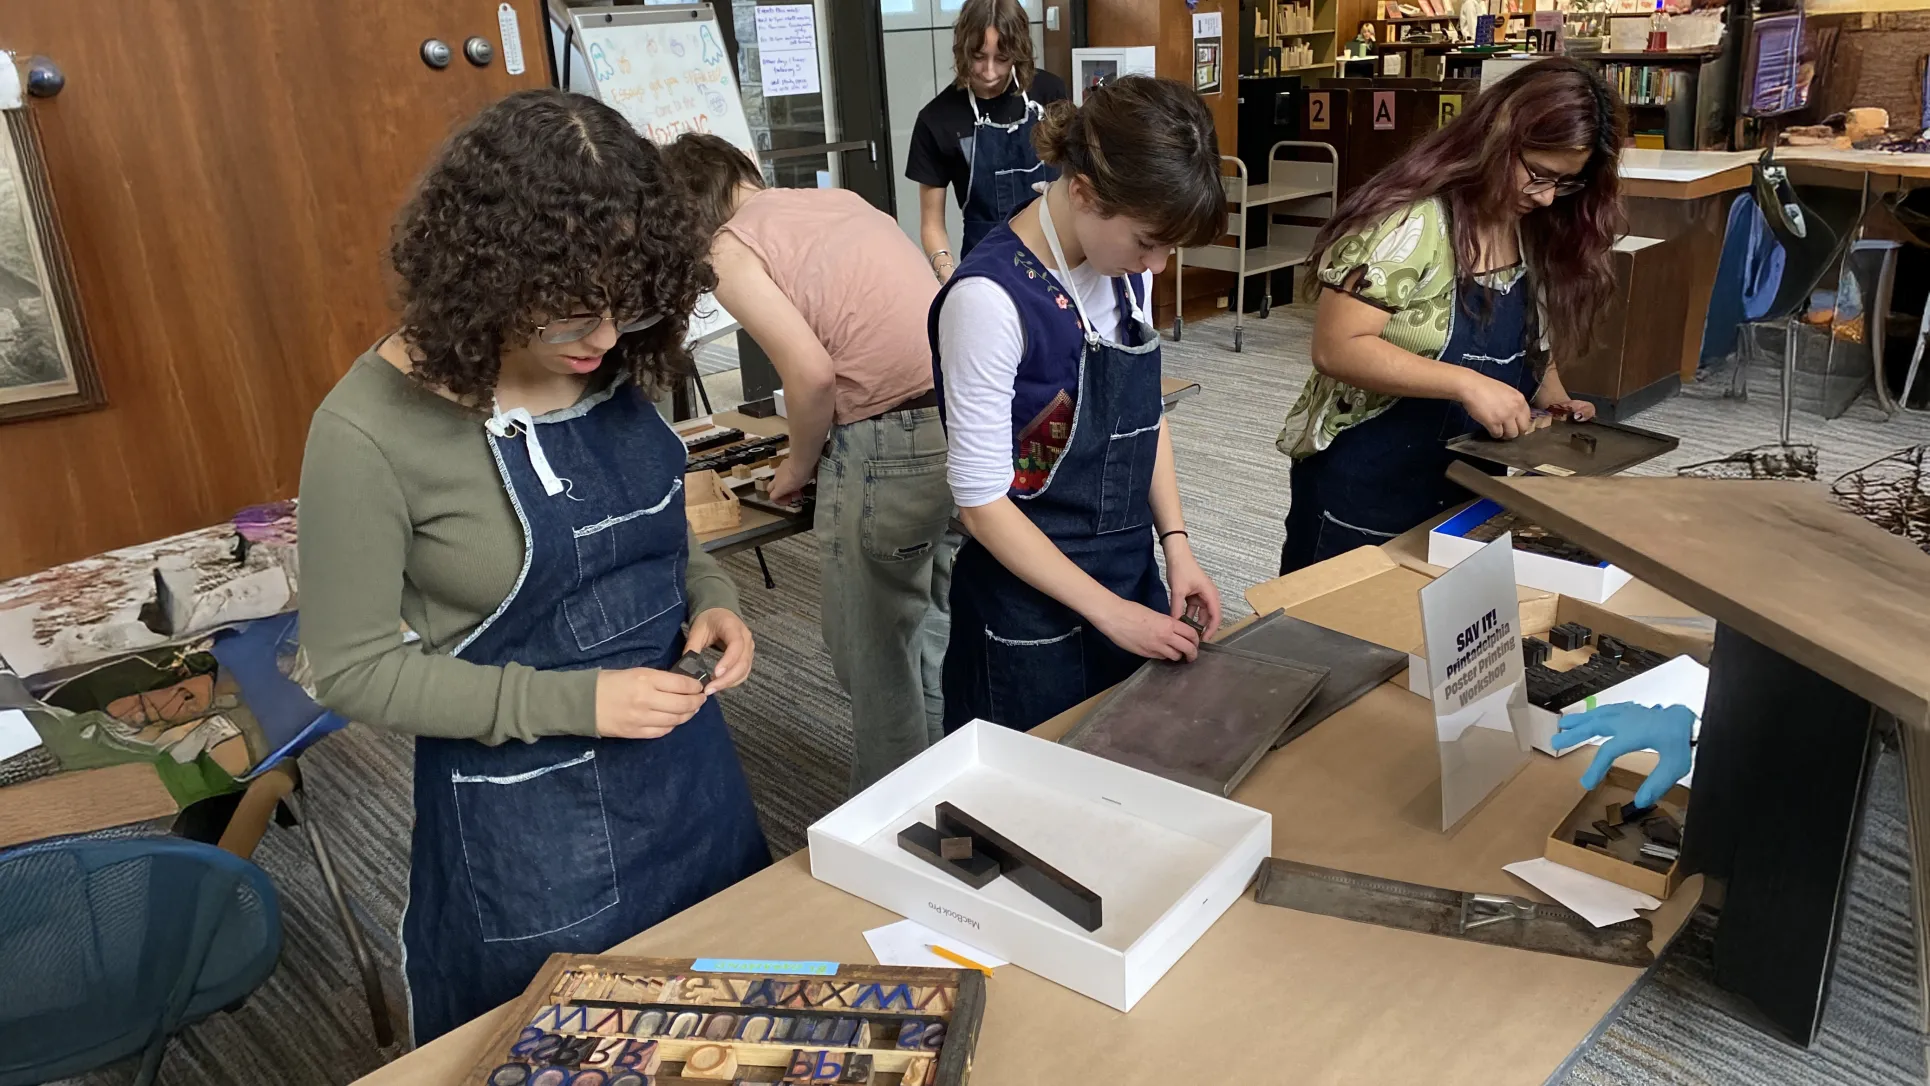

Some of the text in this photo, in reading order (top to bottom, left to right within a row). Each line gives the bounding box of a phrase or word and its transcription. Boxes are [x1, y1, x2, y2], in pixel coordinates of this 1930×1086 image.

[1312, 100, 1325, 122] 2
[1375, 99, 1391, 122] A
[1446, 622, 1511, 679] Printadelphia
[1456, 608, 1498, 652] SAY IT!
[1445, 636, 1516, 700] Poster Printing
[1458, 661, 1506, 707] Workshop
[928, 901, 980, 930] MacBook Pro
